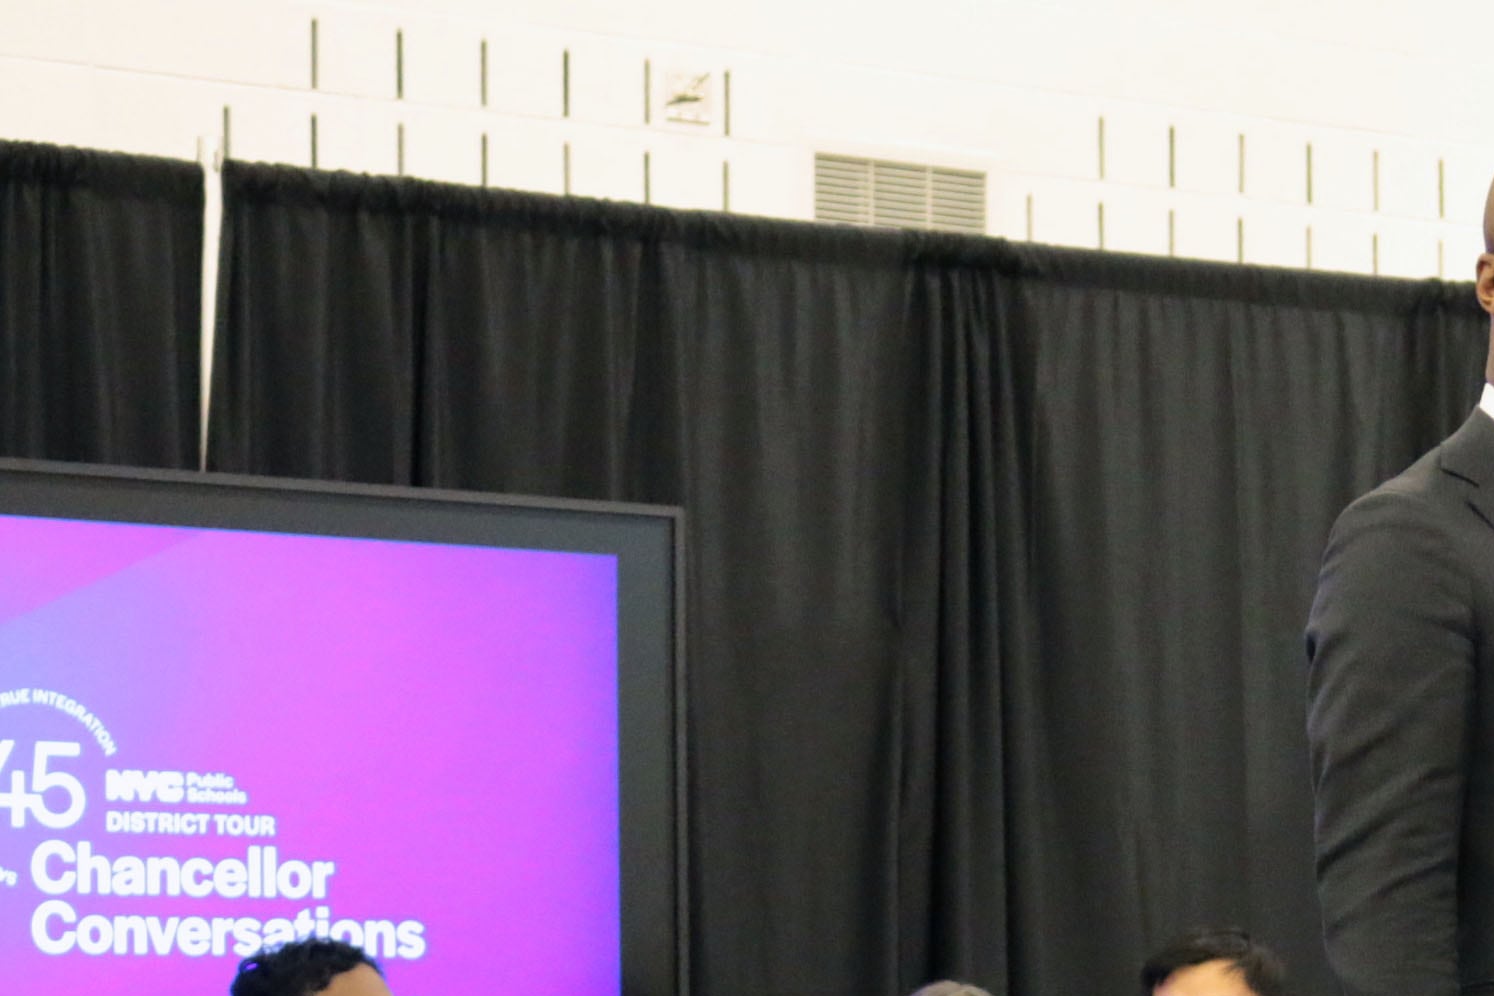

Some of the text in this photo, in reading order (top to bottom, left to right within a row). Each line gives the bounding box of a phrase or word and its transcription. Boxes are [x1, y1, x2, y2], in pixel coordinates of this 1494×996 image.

[32, 688, 117, 757] INTEGRATION
[105, 768, 184, 803] NYC
[186, 771, 234, 789] Public
[186, 787, 248, 804] Schools
[105, 810, 276, 837] DISTRICT TOUR
[31, 839, 335, 899] Chancellor
[31, 899, 427, 959] Conversations
